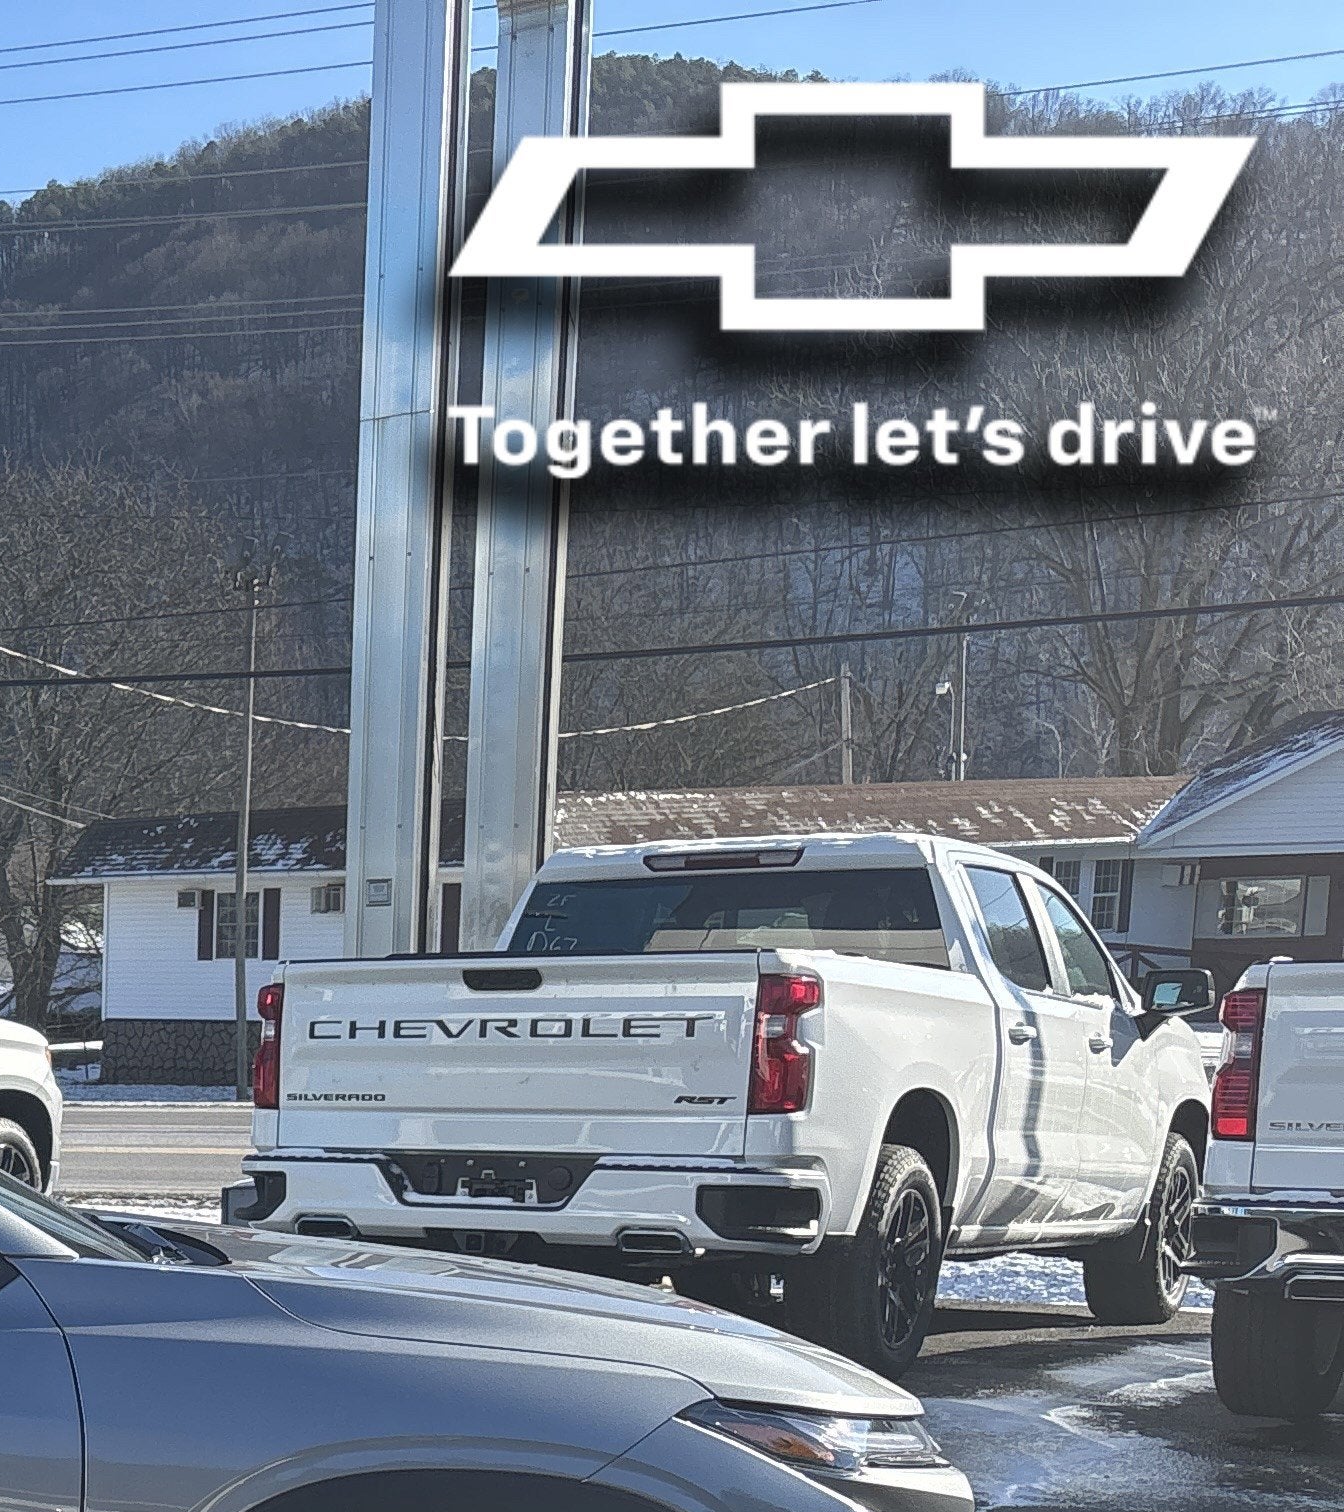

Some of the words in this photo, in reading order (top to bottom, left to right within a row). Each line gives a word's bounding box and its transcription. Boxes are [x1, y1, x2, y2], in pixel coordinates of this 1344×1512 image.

[308, 1016, 714, 1040] CHEVROLET
[286, 1093, 386, 1102] SILVERADO
[674, 1095, 737, 1105] RST
